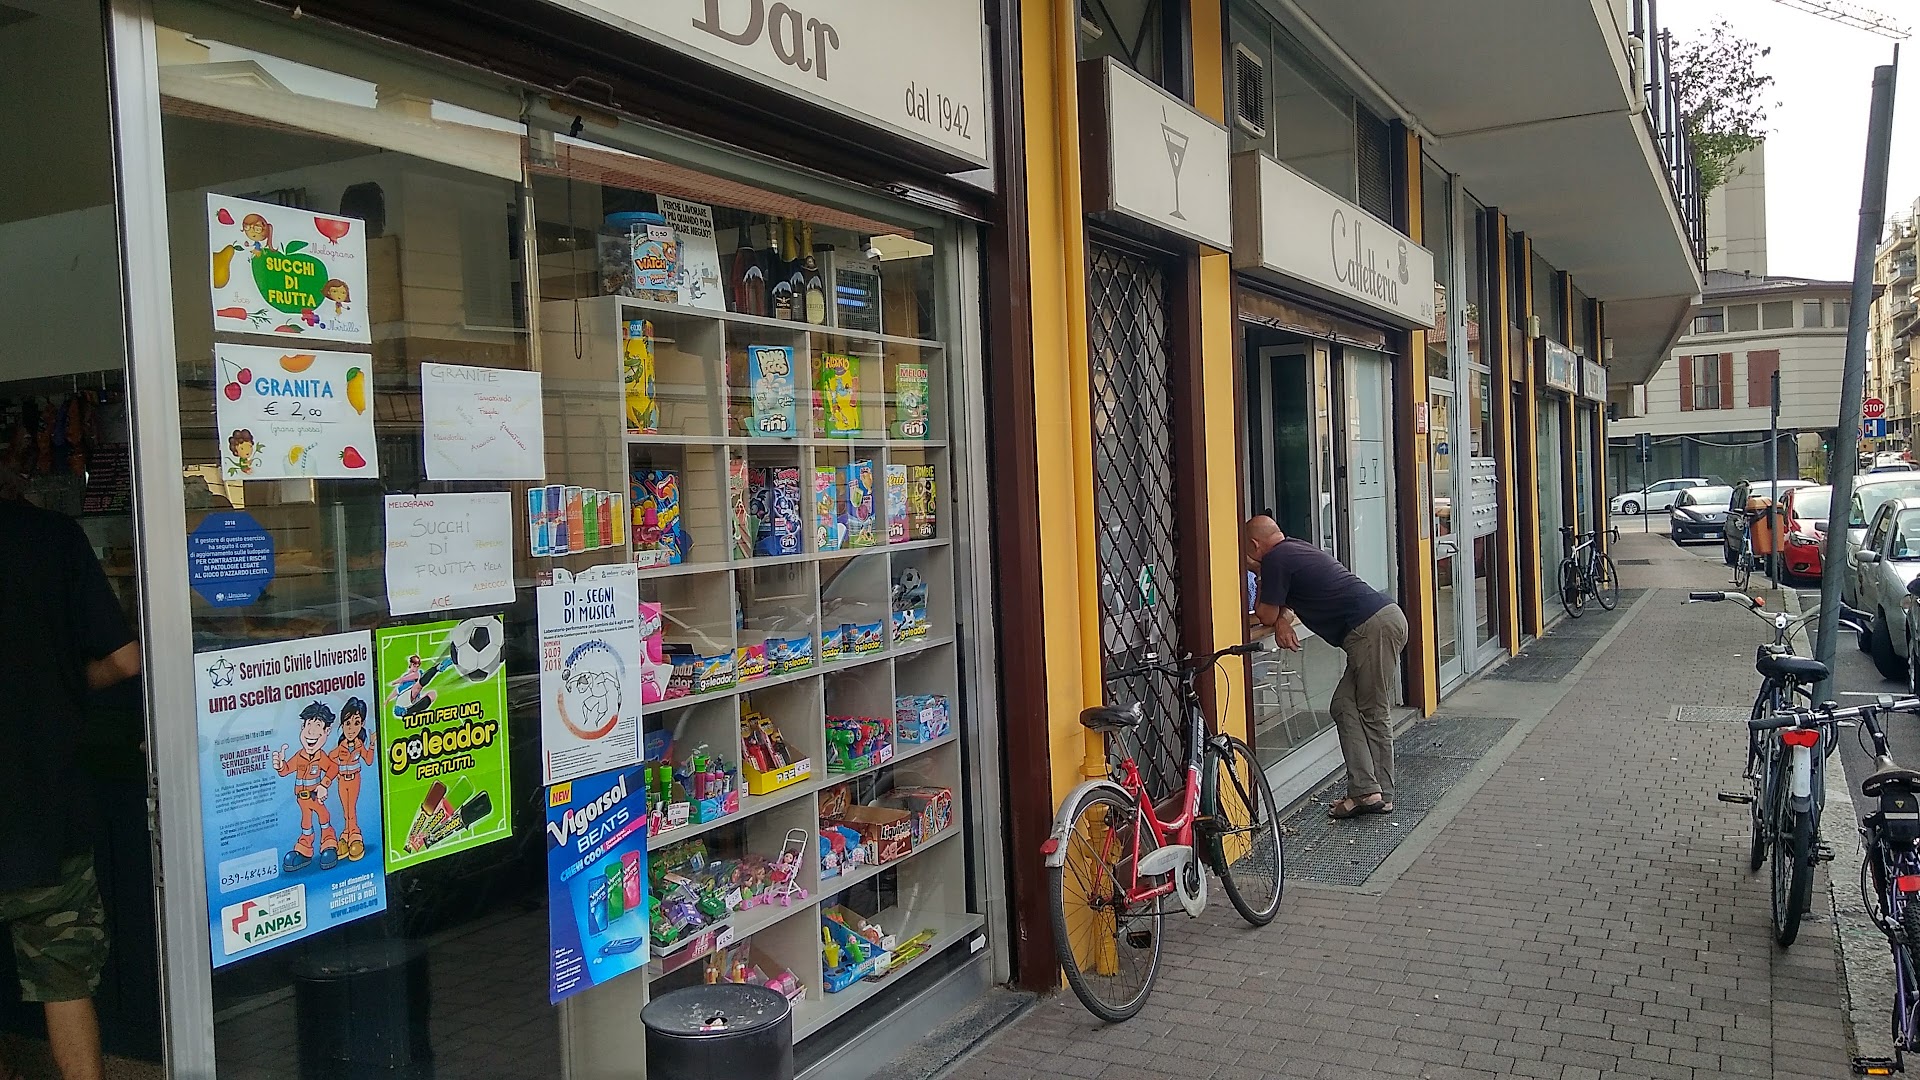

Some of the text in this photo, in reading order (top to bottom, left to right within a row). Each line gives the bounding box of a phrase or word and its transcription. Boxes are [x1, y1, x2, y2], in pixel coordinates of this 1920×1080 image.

[905, 81, 971, 140] dal 1942
[682, 203, 707, 217] LAVORARE
[677, 213, 698, 226] QUANDO
[700, 219, 711, 228] PUOI
[309, 243, 355, 261] Melograno
[1331, 208, 1399, 307] Caffetteria
[266, 257, 315, 276] SUCCHI
[635, 256, 666, 271] WATCH
[285, 276, 298, 289] DI
[268, 290, 317, 307] FRUTTA
[431, 366, 499, 382] GRANITE
[900, 368, 927, 378] MELON
[255, 377, 333, 398] GRANITA
[264, 401, 278, 416] €
[1863, 404, 1884, 413] STOP
[388, 500, 434, 509] MELOGRANO
[411, 513, 470, 538] SUCCHI
[200, 537, 219, 545] gestore
[226, 536, 243, 544] questo
[429, 536, 448, 555] DI
[208, 556, 246, 564] CONTRASTARE
[484, 562, 502, 571] MELA
[415, 561, 476, 577] FRUTTA
[472, 580, 508, 591] ALBICOCCA
[430, 595, 453, 608] ACE
[564, 590, 575, 606] DI
[587, 586, 614, 604] SEGNI
[564, 603, 616, 624] DI MUSICA
[900, 627, 927, 641] goleador
[544, 647, 561, 659] 30.09
[855, 641, 880, 654] goleador
[239, 644, 367, 681] Servizio Civile Universale
[545, 658, 561, 671] 2018
[784, 656, 810, 671] goleador
[700, 674, 733, 691] goleador
[208, 671, 366, 714] una scelta consapevole
[403, 702, 484, 728] TUTTI PER UNO,
[220, 752, 235, 761] PUOI
[236, 747, 261, 758] ADERIRE
[391, 722, 496, 772] goleador
[222, 753, 269, 769] SERVIZIO CIVILE
[417, 755, 475, 779] PER TUTTI.
[227, 762, 266, 777] UNIVERSALE
[552, 788, 571, 804] NEW
[547, 773, 628, 846] Vigorsol
[577, 807, 630, 854] BEATS
[560, 844, 605, 882] CHEW COOL
[347, 873, 370, 885] dinamico
[330, 886, 377, 909] unisciti a noi!
[331, 898, 378, 919] www.anpas.org
[254, 910, 302, 938] ANPAS
